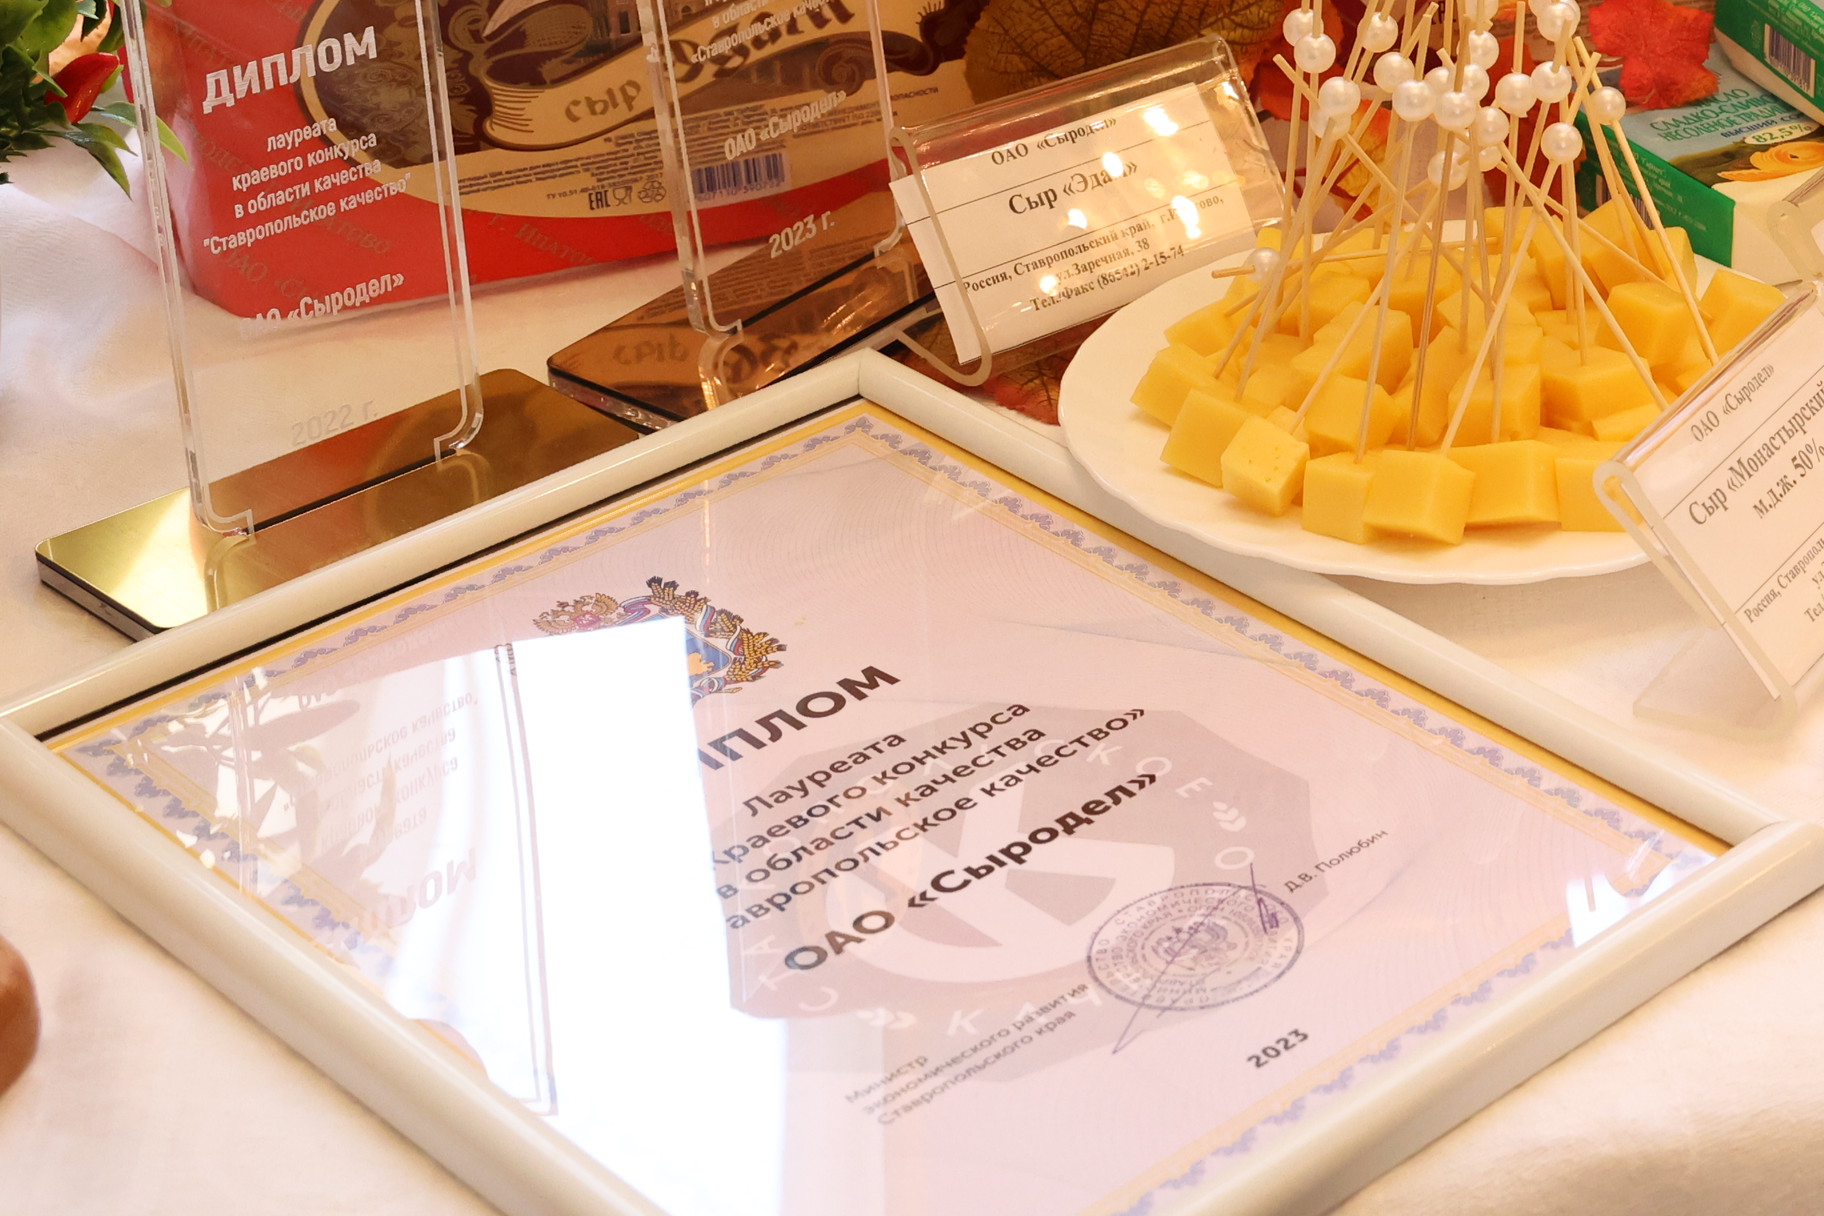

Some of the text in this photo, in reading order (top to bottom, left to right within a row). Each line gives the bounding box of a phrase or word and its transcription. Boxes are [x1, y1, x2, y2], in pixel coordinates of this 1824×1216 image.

[202, 26, 377, 114] ДИПЛОМ
[267, 118, 337, 152] лауреата
[724, 90, 847, 160] ОАО «Сыродел»
[991, 142, 1029, 166] ОАО
[1752, 124, 1813, 143] 82,5%
[232, 133, 377, 192] краевого конкурса
[235, 160, 382, 218] в области качества
[1008, 161, 1138, 215] Сыр «Эда»
[203, 201, 336, 255] "Ставропольское
[769, 214, 817, 259] 2023
[1136, 237, 1150, 252] 38
[963, 273, 1013, 294] Россия,
[1013, 228, 1119, 277] Ставропольский
[1143, 245, 1185, 271] 2-15-74
[287, 273, 405, 320] «Сыродел»
[1690, 363, 1775, 442] ОАО «Сыродел»
[1688, 488, 1729, 525] Сыр
[1752, 472, 1798, 520] м.д.ж.
[1744, 586, 1782, 624] Россия,
[698, 665, 901, 772] ПЛОМ
[871, 702, 1032, 786] конкурса
[742, 732, 907, 817] Лауреата
[717, 727, 1047, 901] в области качества
[725, 707, 1146, 932] авропольское качество»
[783, 772, 1159, 971] ОАО «Сыродел»
[1284, 829, 1389, 893] Д.В. Полюбин
[861, 983, 1088, 1116] экономического развития
[877, 1010, 1076, 1126] Ставропольского края
[1247, 1028, 1310, 1069] 2023
[844, 1054, 929, 1104] Министр
